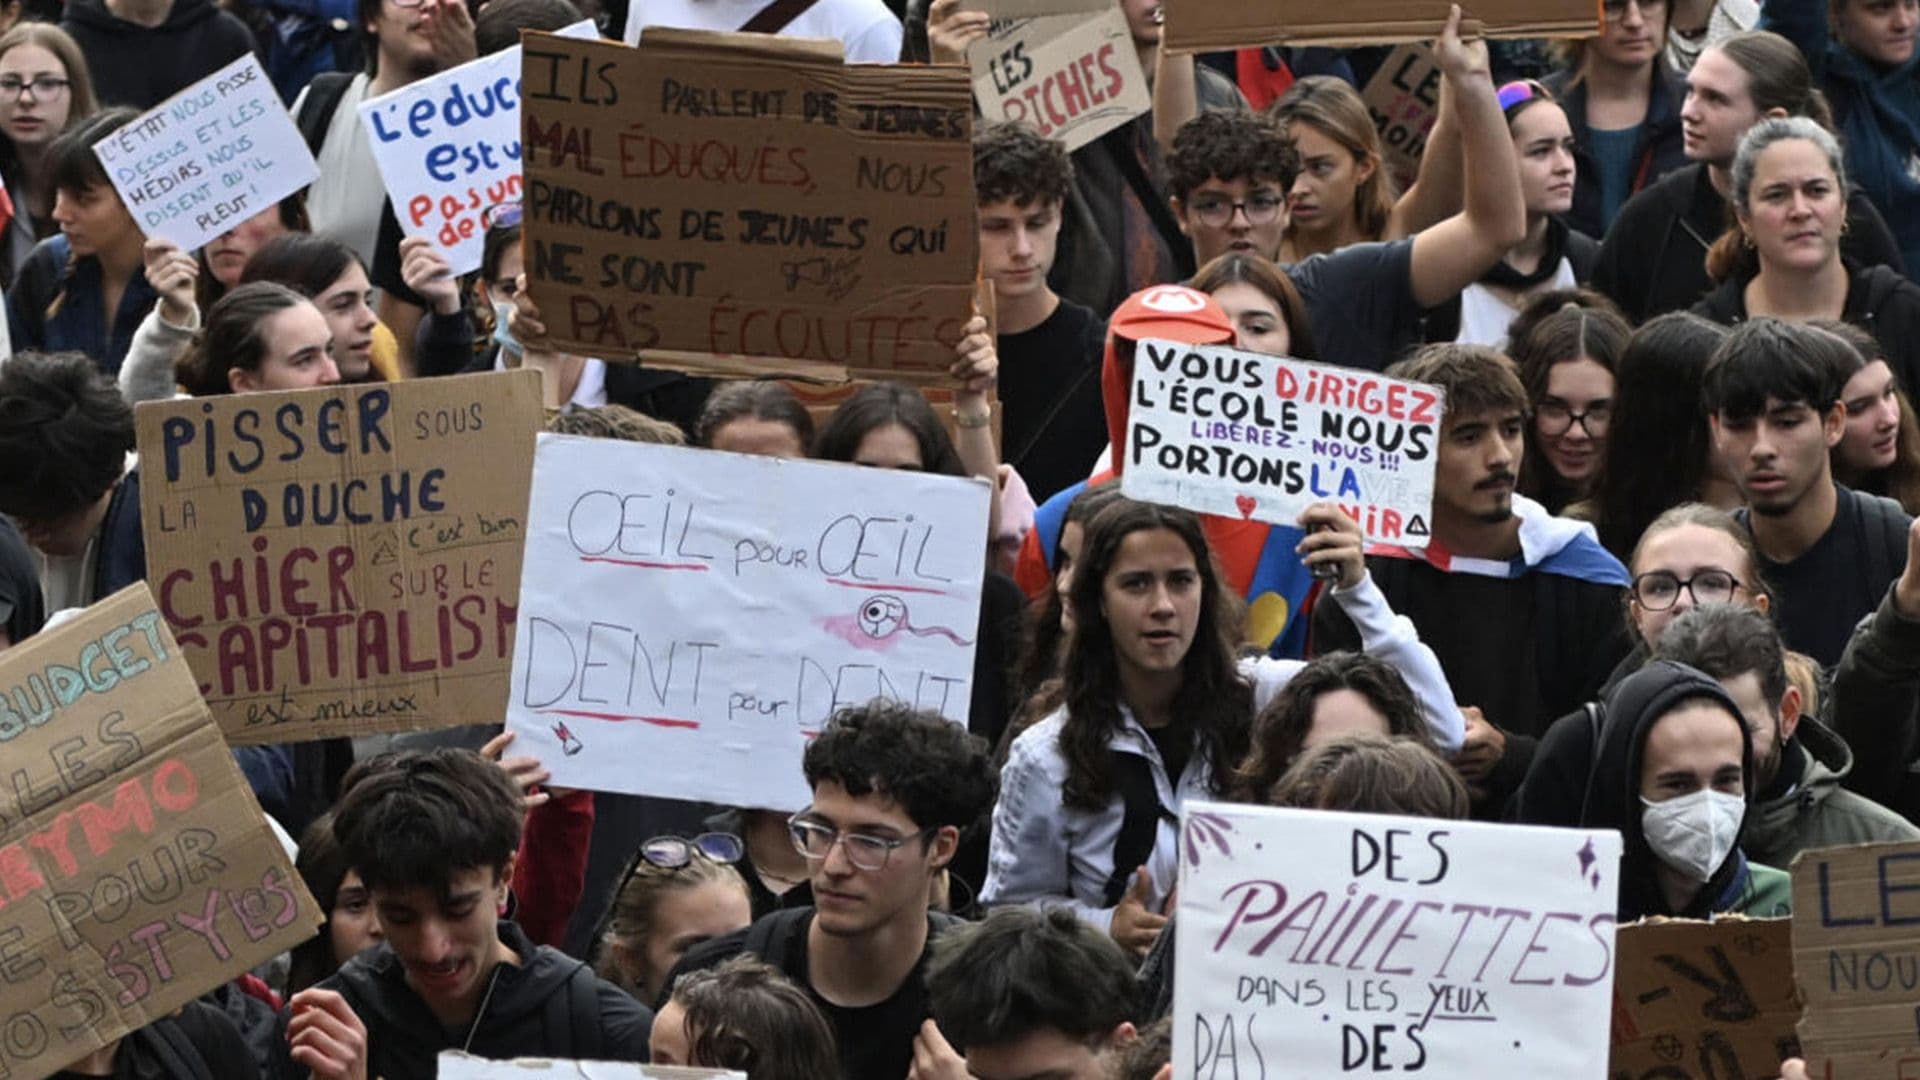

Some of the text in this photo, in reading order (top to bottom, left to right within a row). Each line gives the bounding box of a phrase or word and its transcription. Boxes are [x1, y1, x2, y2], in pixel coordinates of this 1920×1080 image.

[524, 50, 619, 106] ILS
[661, 77, 787, 121] PARLENT
[804, 90, 840, 126] DE
[989, 40, 1033, 96] LES
[101, 64, 258, 163] L'ÉTAT NOUS PISSE
[371, 76, 523, 143] L'educ
[117, 97, 267, 186] DESSUS ET LES
[205, 133, 255, 169] NOUS
[425, 140, 500, 183] est
[525, 115, 606, 176] MAL
[856, 156, 951, 197] NOUS
[143, 182, 214, 229] DISENT
[530, 180, 663, 241] PARLONS
[680, 208, 725, 244] DE
[738, 208, 870, 252] JEUNES
[533, 239, 706, 297] NE SONT
[569, 295, 661, 351] PAS
[1146, 343, 1264, 389] VOUS
[414, 402, 485, 441] SOUS
[1136, 377, 1434, 461] L'ÉCOLE NOUS
[158, 467, 447, 534] LA DOUCHE
[389, 564, 450, 600] SUR
[463, 559, 495, 589] LE
[523, 616, 720, 709] DENT
[309, 693, 419, 723] mieux
[1351, 828, 1451, 886] DES
[46, 827, 228, 951] POUR
[1236, 975, 1492, 1032] DANS LES YEUX
[1193, 1012, 1427, 1080] PAS DES
